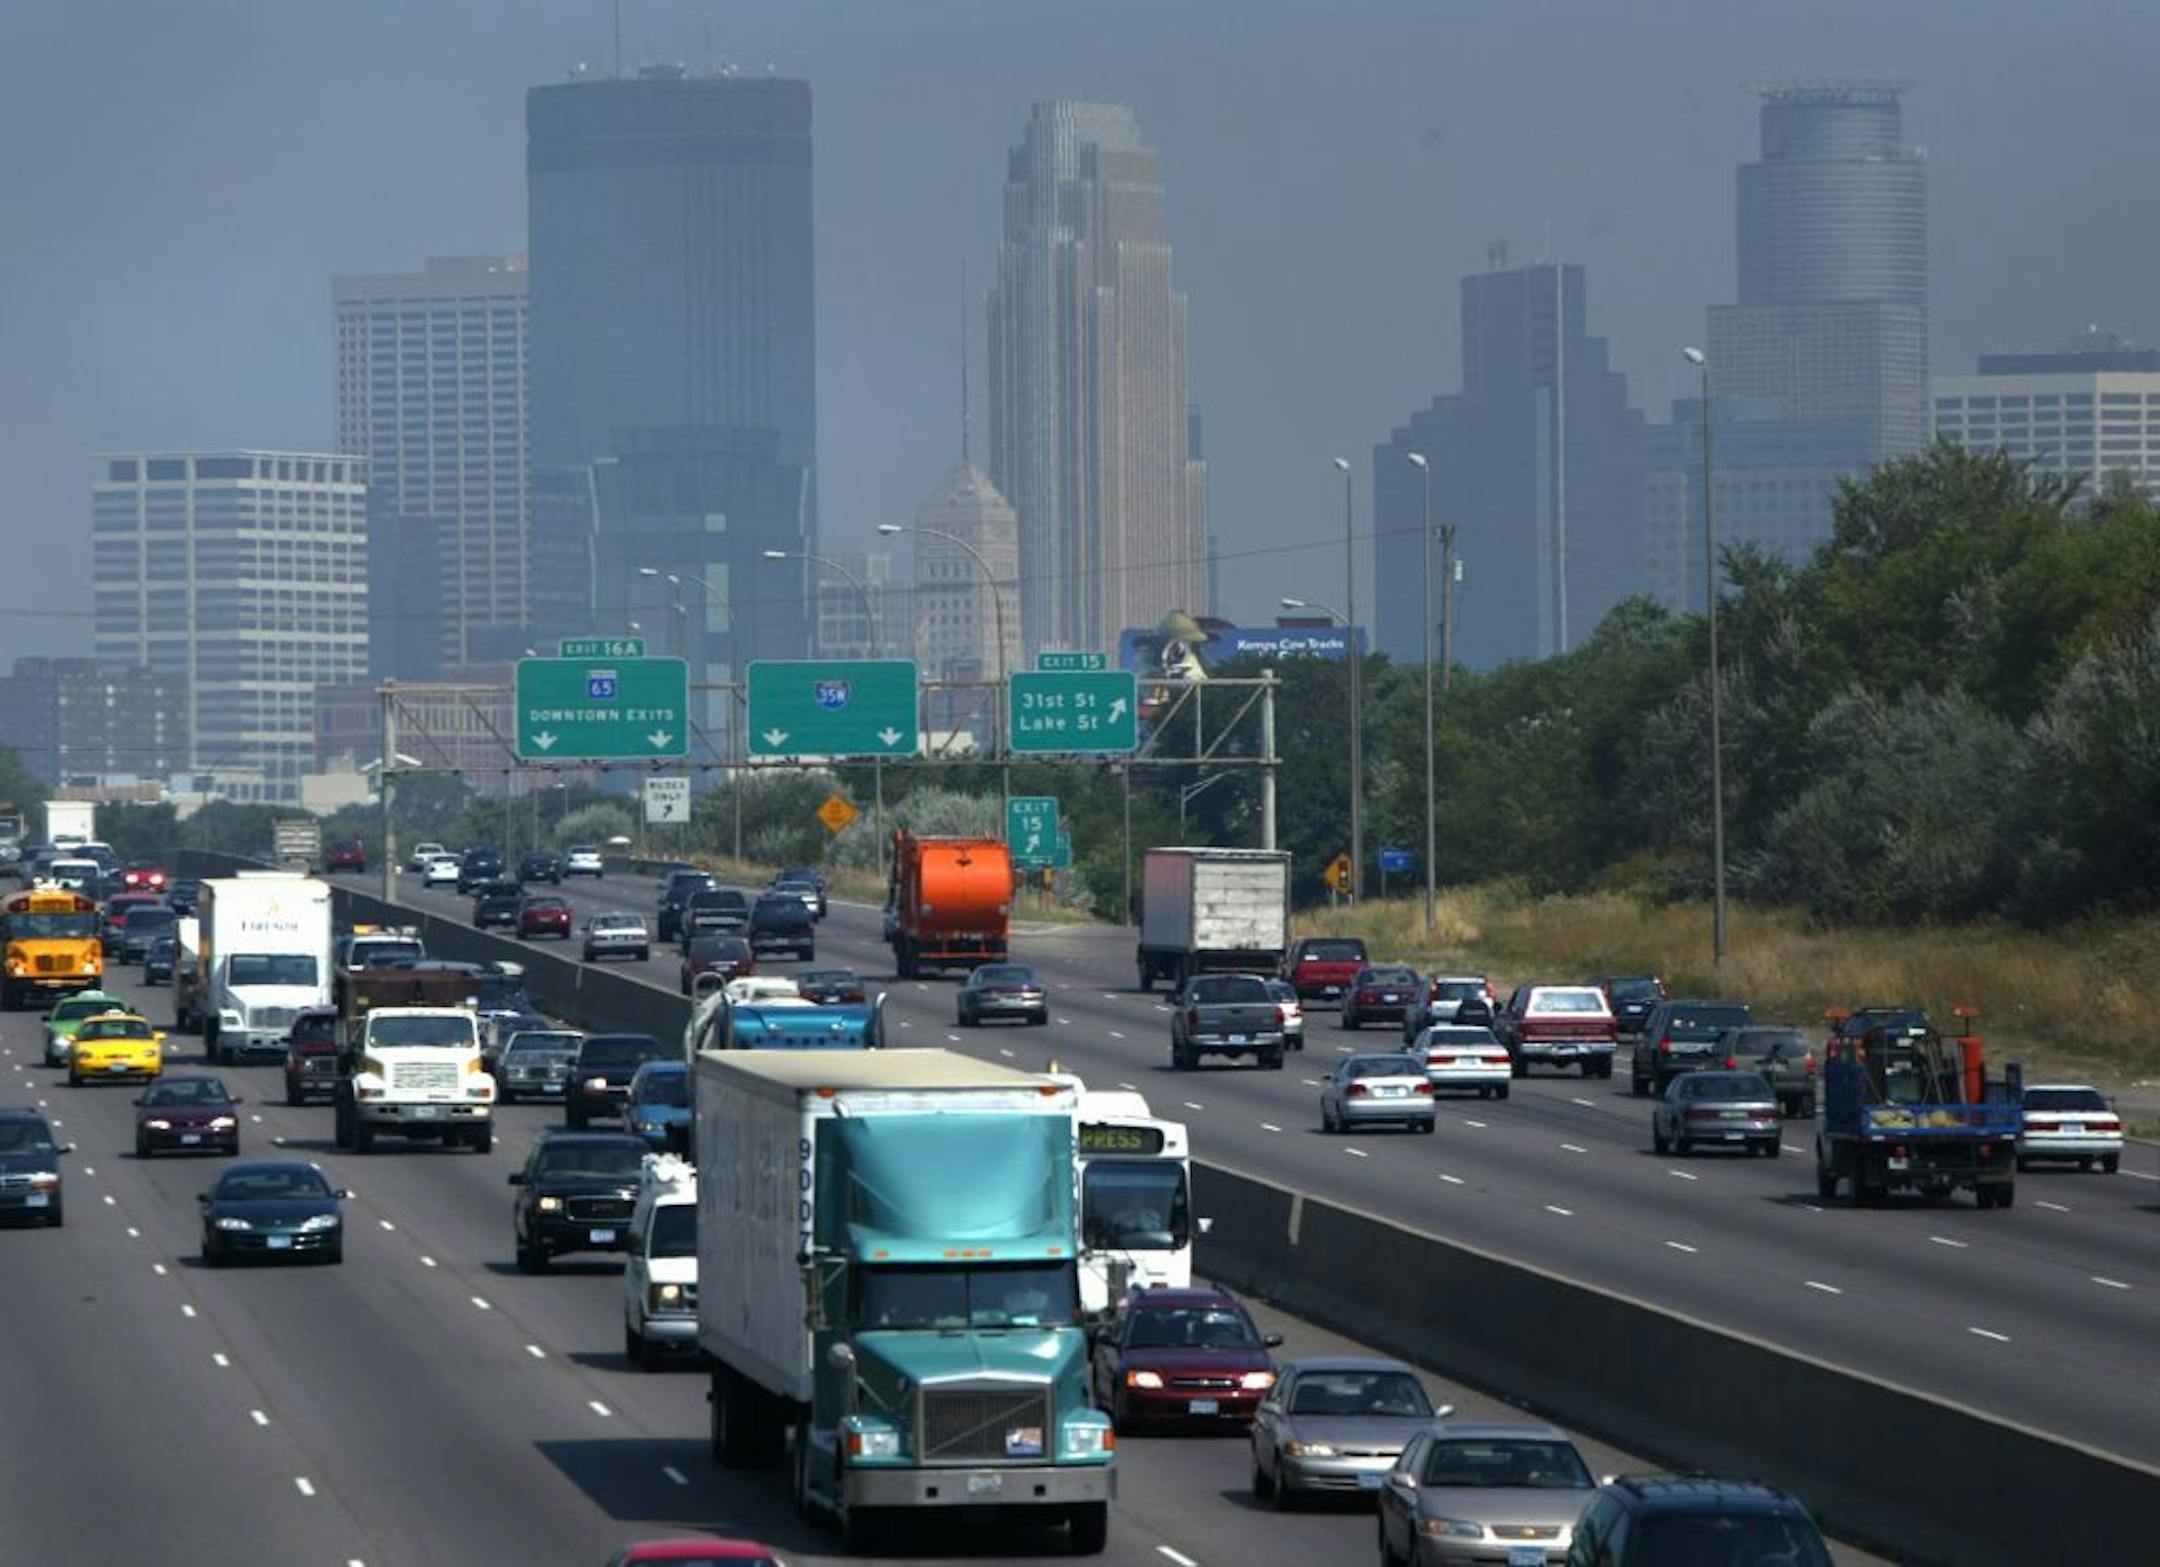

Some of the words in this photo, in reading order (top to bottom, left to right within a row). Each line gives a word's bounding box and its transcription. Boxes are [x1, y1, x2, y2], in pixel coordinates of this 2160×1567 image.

[566, 643, 599, 655] EXIT
[604, 641, 638, 655] 16A
[1042, 656, 1075, 668] EXIT
[1080, 654, 1101, 669] 15
[819, 688, 846, 704] 35W
[1021, 692, 1064, 708] 31st
[1074, 692, 1095, 708] St
[529, 708, 619, 722] DOWNTOWN
[627, 708, 674, 721] EXITS
[1020, 715, 1066, 731] Lake
[1077, 714, 1098, 730] St
[1013, 802, 1050, 813] EXIT
[1022, 817, 1042, 832] 15
[799, 1138, 811, 1255] 9007
